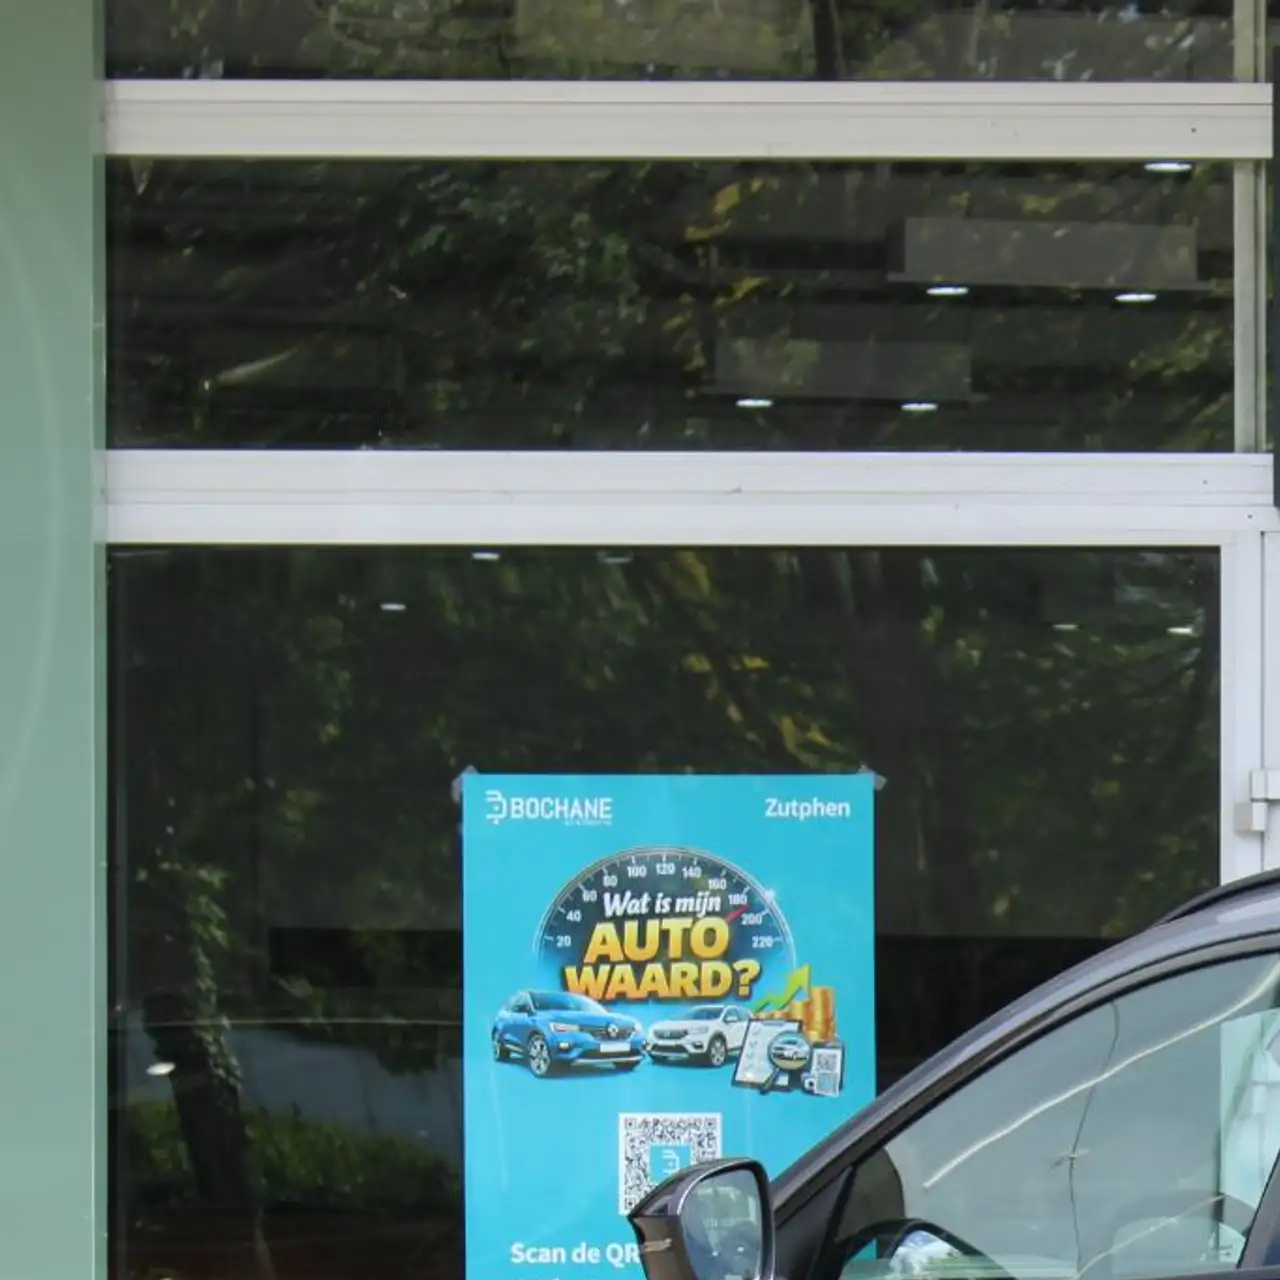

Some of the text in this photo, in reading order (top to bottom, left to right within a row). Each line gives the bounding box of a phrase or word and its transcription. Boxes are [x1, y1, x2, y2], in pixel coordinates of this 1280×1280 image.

[510, 797, 614, 820] BOCHANE
[764, 796, 851, 821] Zutphen
[626, 865, 648, 878] 100
[655, 862, 676, 875] 120
[681, 865, 703, 879] 140
[602, 890, 722, 919] Wat is mijn
[566, 909, 582, 922] 40
[741, 913, 762, 926] 200
[556, 935, 572, 949] 20
[583, 915, 730, 963] AUTO
[751, 935, 774, 949] 220
[564, 958, 761, 999] WAARD?
[510, 1241, 641, 1269] Scan de QR
